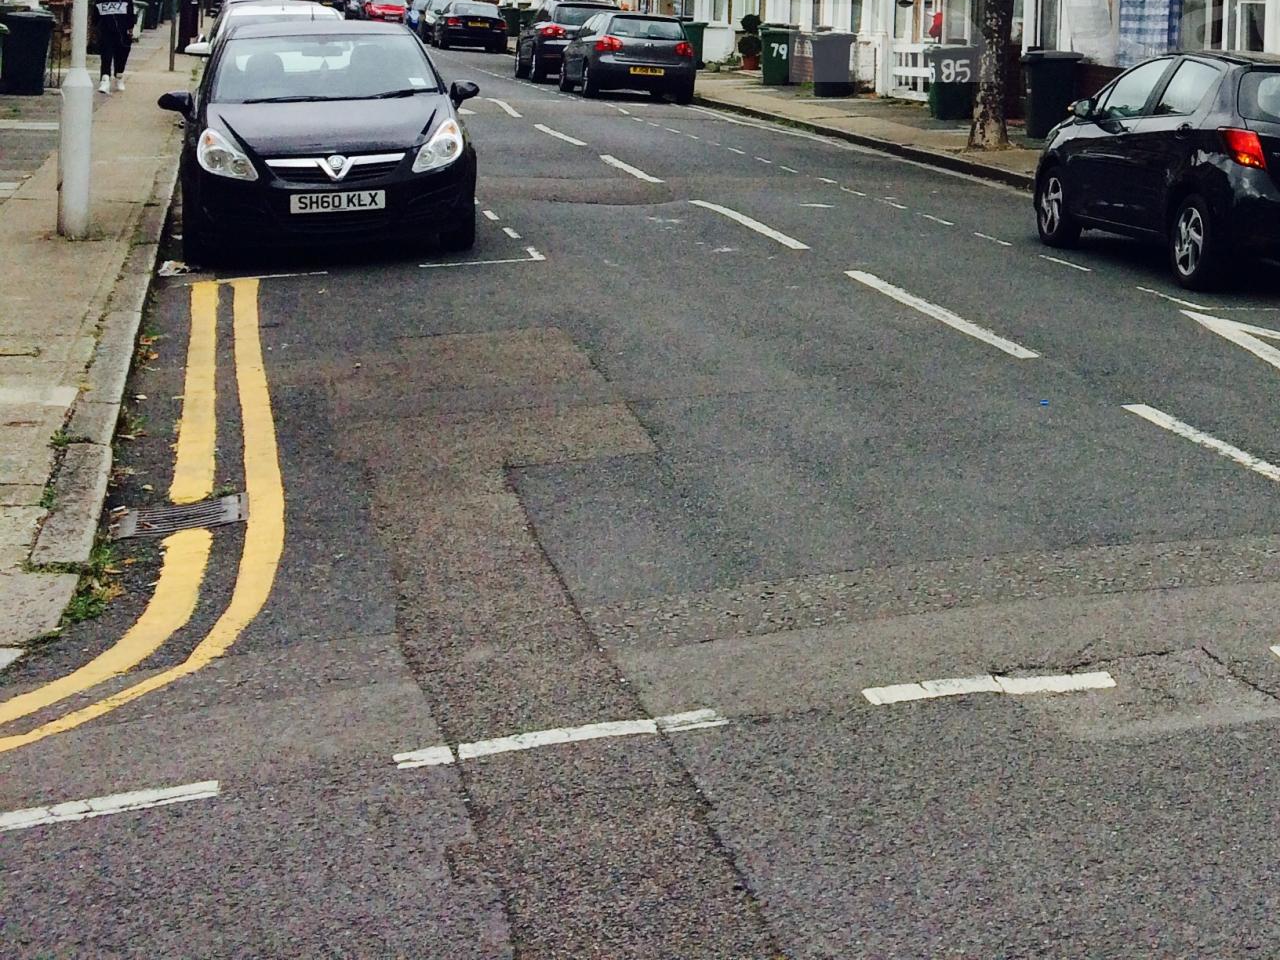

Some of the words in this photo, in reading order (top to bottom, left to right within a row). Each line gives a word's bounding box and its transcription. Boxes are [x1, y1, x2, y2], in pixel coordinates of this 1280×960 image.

[770, 42, 789, 60] 79
[941, 59, 971, 83] 85
[298, 194, 342, 210] SH60
[346, 192, 378, 208] KLX
